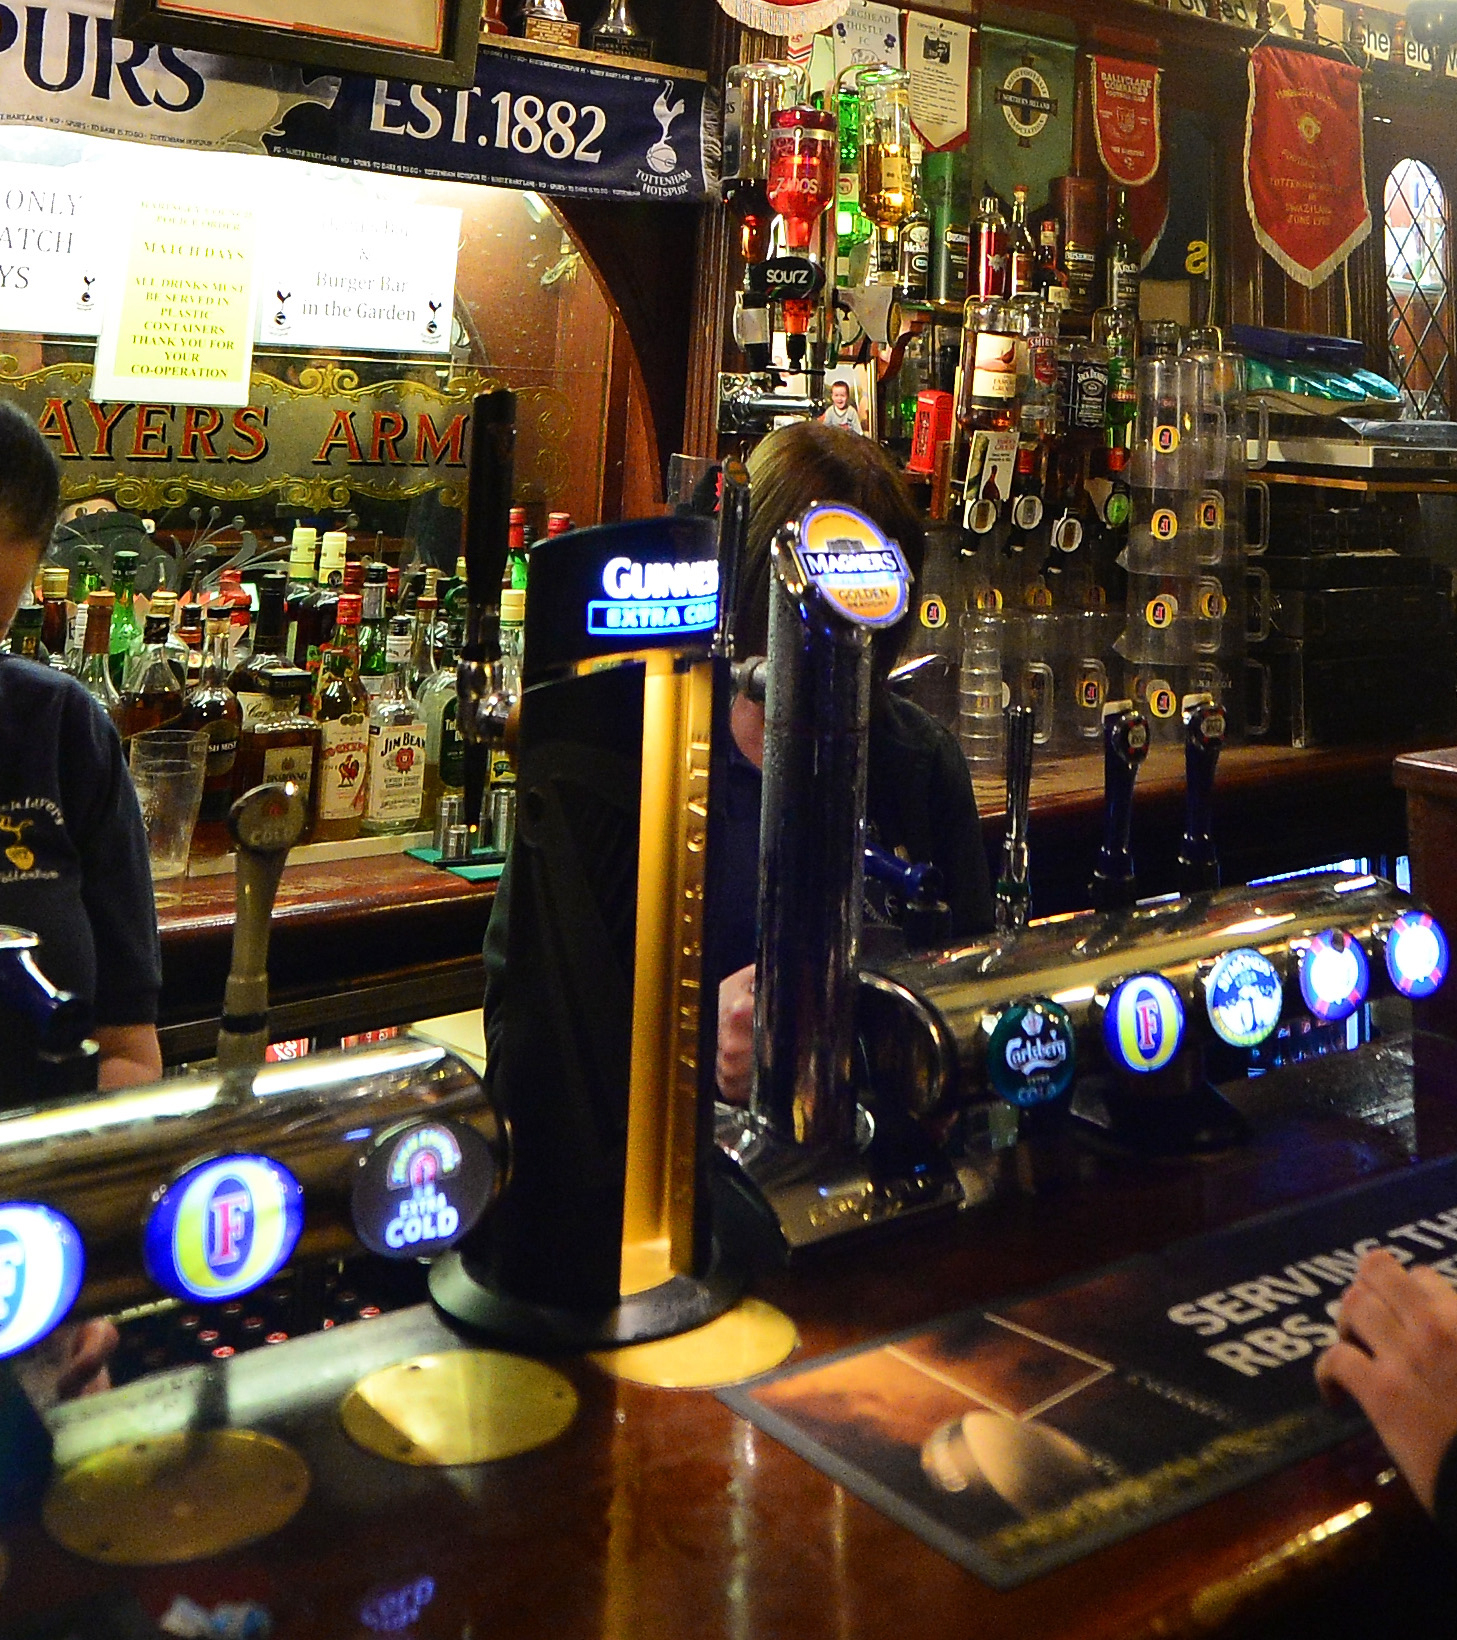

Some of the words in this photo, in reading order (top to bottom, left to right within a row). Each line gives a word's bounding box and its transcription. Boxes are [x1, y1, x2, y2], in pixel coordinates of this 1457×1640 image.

[1100, 71, 1153, 89] BALLYCLARE
[1103, 80, 1149, 97] COMRADES
[635, 167, 692, 188] TOTTENHAM
[4, 186, 84, 217] ONLY
[642, 183, 689, 198] HOTSPUR
[144, 241, 201, 258] MATCH
[204, 245, 245, 260] DAYS
[160, 277, 209, 291] DRINKS
[315, 271, 375, 293] Burger
[379, 275, 409, 293] Bar
[145, 291, 160, 303] BE
[163, 293, 215, 306] SERVED
[216, 296, 230, 307] IN
[159, 307, 212, 320] PLASTIC
[301, 301, 320, 316] in
[324, 300, 353, 318] the
[355, 301, 416, 322] Garden
[143, 321, 226, 335] CONTAINERS
[131, 334, 176, 347] THANK
[178, 336, 207, 349] YOU
[208, 339, 235, 351] FOR
[162, 350, 200, 363] YOUR
[130, 363, 229, 379] CO-OPERATION
[313, 408, 472, 467] ARM
[806, 551, 898, 575] MAGNERS
[602, 557, 720, 600] GUINNES
[837, 588, 890, 602] GOLDEN
[606, 603, 680, 628] EXTRA
[380, 734, 402, 757] JIM
[1137, 998, 1160, 1049] F
[1004, 1031, 1068, 1076] Carlsberg
[208, 1189, 249, 1260] F
[384, 1211, 459, 1249] COLD
[1166, 1238, 1410, 1338] SERVING
[1204, 1320, 1339, 1378] RBS
